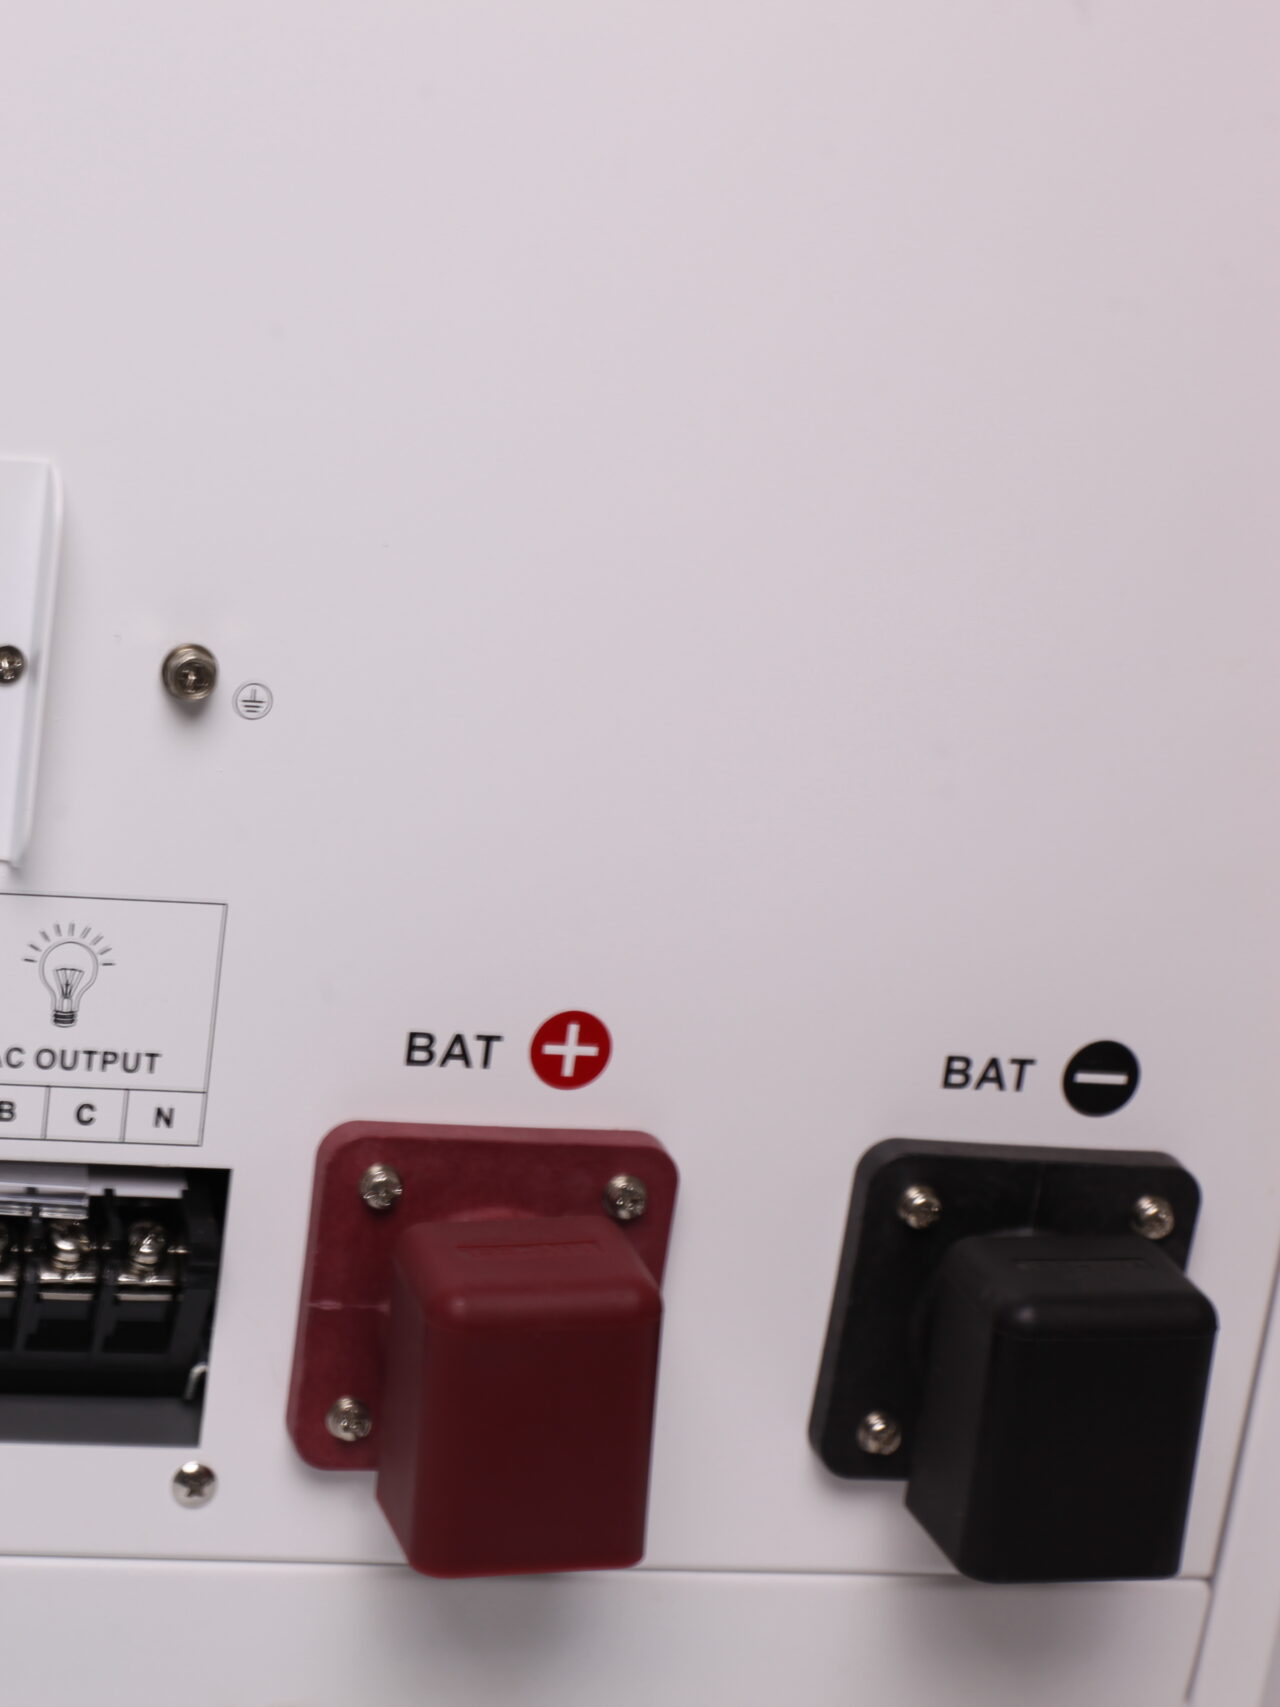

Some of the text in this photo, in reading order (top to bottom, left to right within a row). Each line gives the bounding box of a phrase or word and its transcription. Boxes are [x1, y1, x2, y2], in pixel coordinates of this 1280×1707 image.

[35, 1048, 163, 1076] OUTPUT
[405, 1031, 503, 1070] BAT
[942, 1056, 1036, 1093] BAT
[75, 1103, 97, 1127] C
[154, 1106, 174, 1130] N
